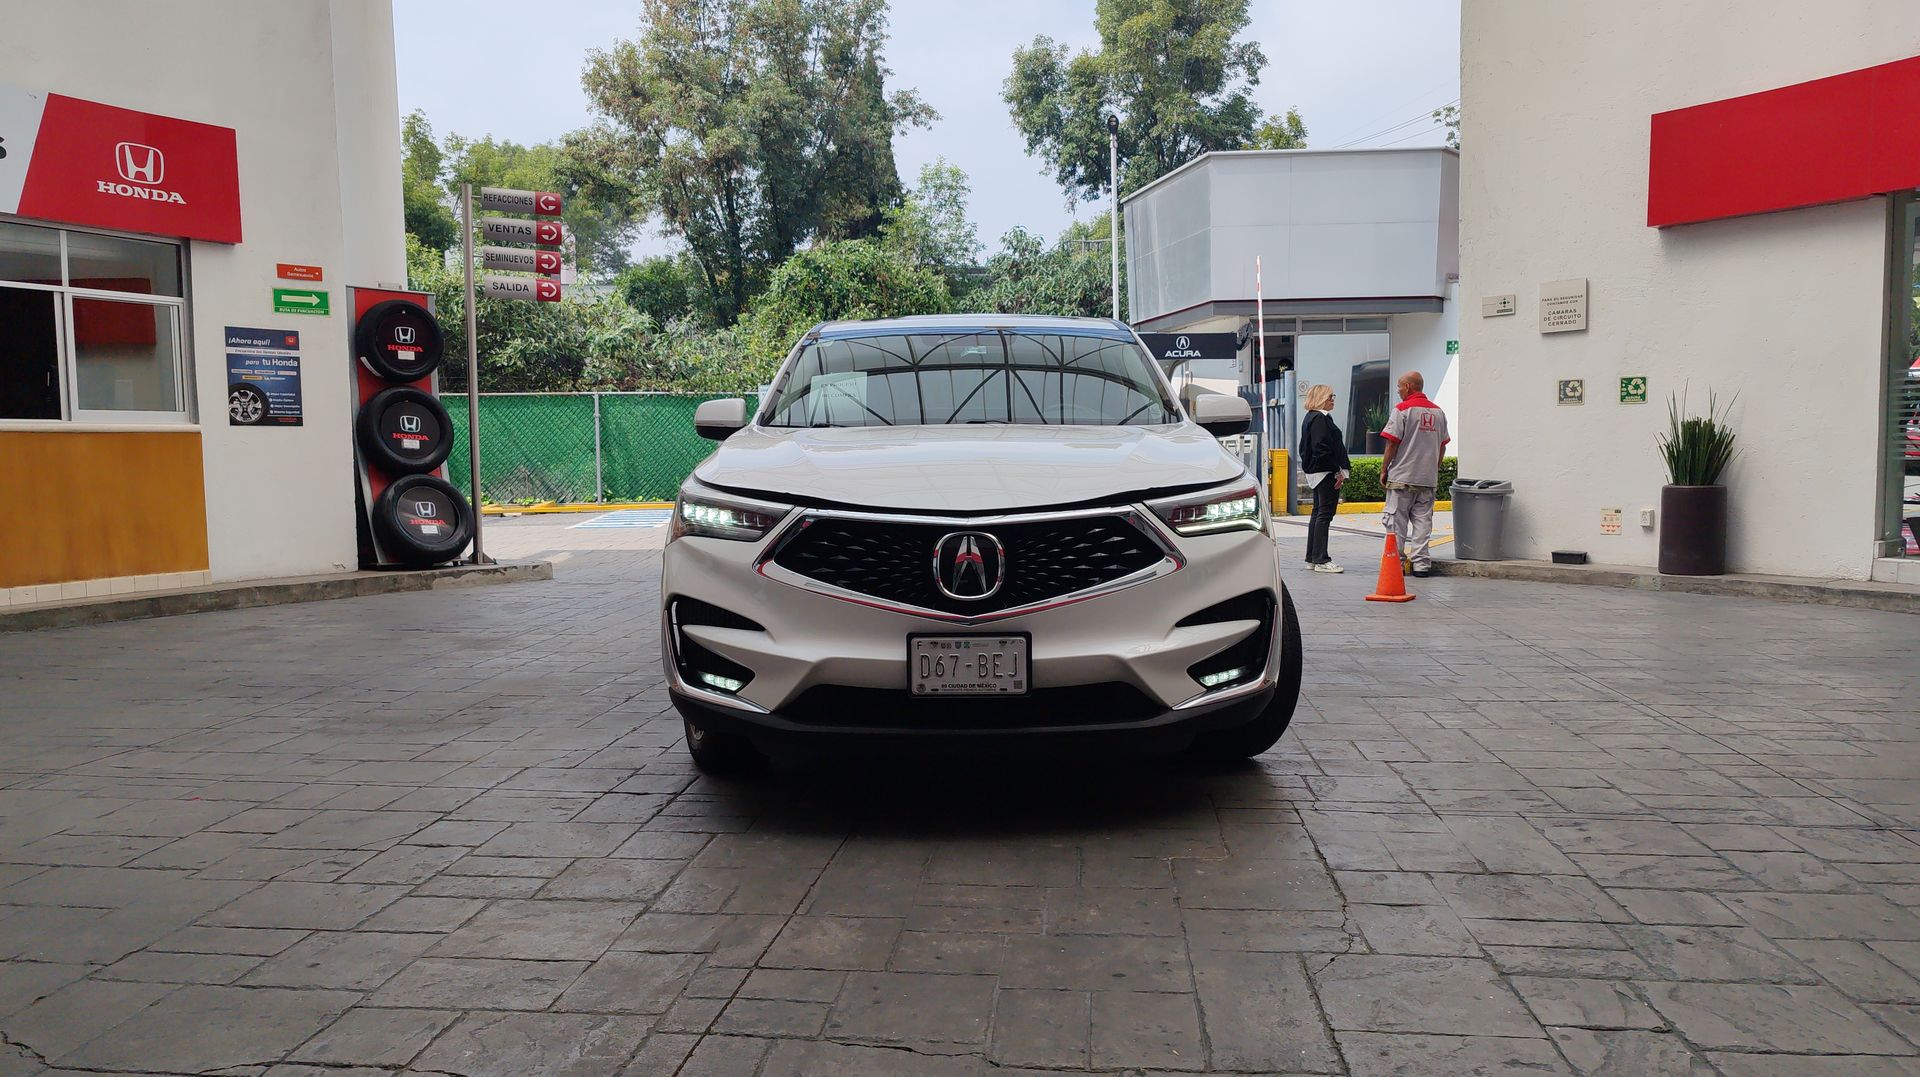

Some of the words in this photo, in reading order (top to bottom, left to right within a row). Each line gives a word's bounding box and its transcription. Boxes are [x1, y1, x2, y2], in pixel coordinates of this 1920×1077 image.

[97, 180, 187, 205] HONDA
[483, 193, 533, 206] REFACCIONES
[488, 223, 532, 235] VENTAS
[485, 252, 534, 265] SEMINUEVOS
[492, 281, 529, 293] SALIDA
[1553, 313, 1582, 321] CIRCUITO
[1547, 319, 1577, 327] CERRADO
[387, 344, 424, 353] HONDA
[1164, 350, 1202, 358] ACURA
[262, 358, 271, 366] tu
[272, 358, 298, 367] Honda
[392, 432, 430, 441] HONDA
[919, 652, 1018, 678] D67-BEJ
